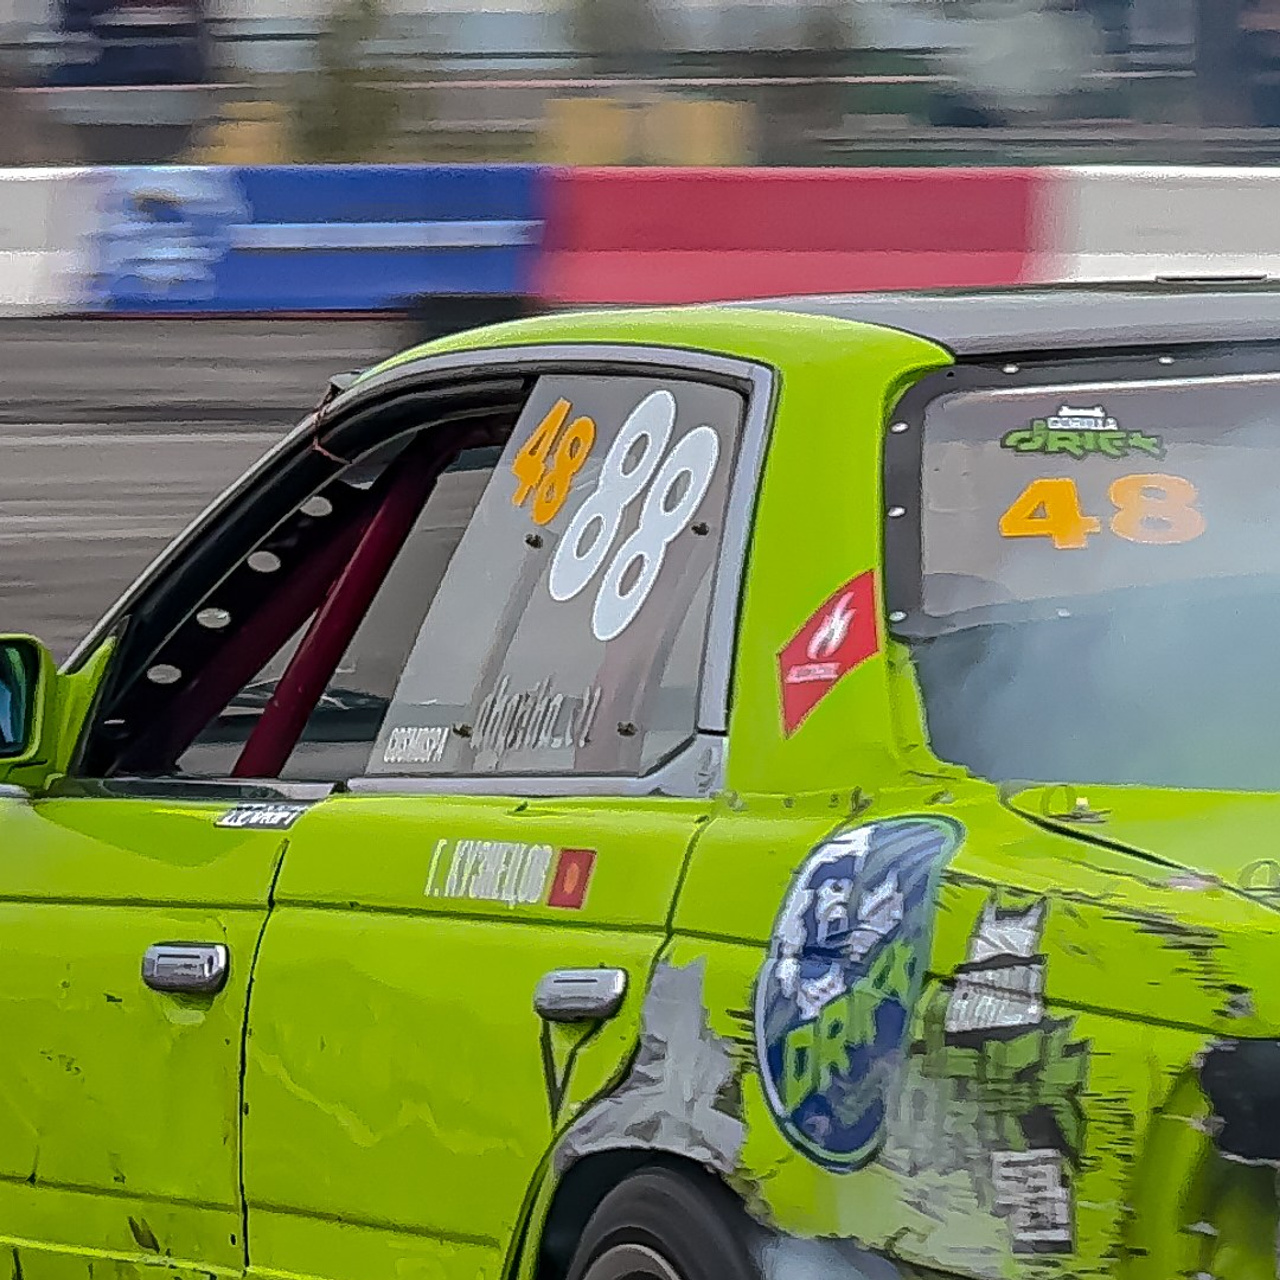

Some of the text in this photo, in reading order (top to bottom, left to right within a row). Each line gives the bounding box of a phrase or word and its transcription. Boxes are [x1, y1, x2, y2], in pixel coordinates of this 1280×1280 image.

[511, 397, 597, 526] 48
[549, 389, 720, 642] 88
[998, 472, 1207, 550] 48
